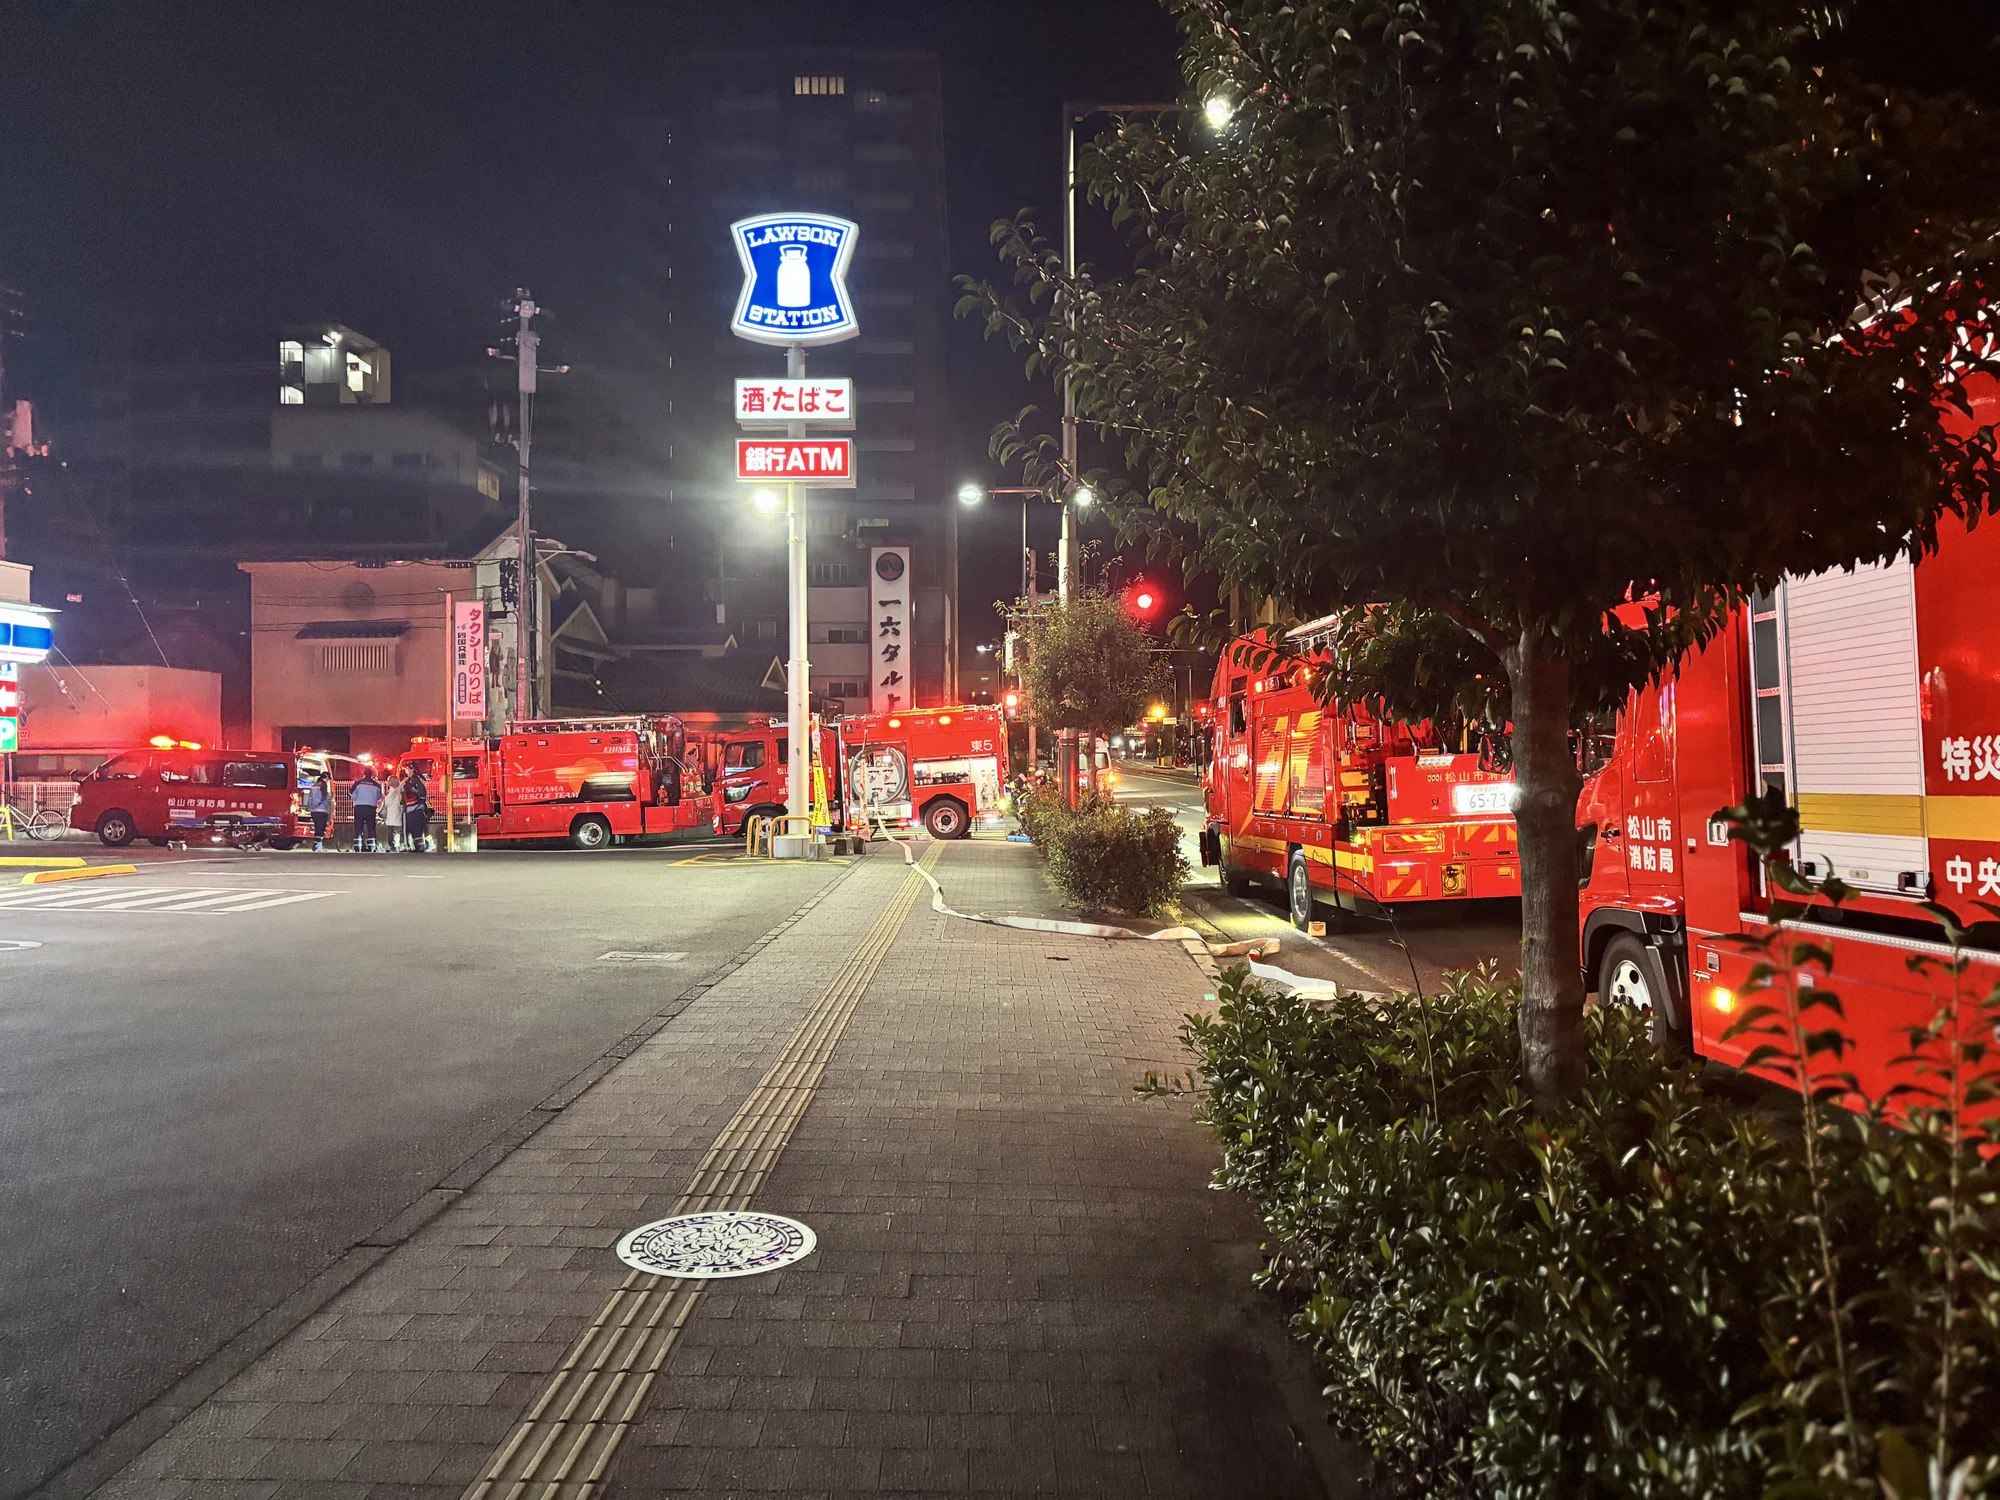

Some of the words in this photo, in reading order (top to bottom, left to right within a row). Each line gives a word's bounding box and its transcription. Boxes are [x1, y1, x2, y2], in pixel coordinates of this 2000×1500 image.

[747, 226, 841, 248] LAWSON
[748, 305, 840, 327] STATION
[745, 446, 843, 473] 銀行ATM
[469, 608, 481, 704] タクシーのりば
[879, 598, 903, 713] 一六タルト
[603, 745, 632, 754] EHIME
[970, 739, 993, 752] 東5
[1941, 735, 2000, 782] 特災
[506, 785, 565, 794] MATSUYAMA
[517, 792, 552, 800] RESCUE
[555, 791, 579, 799] TEAM
[167, 798, 225, 808] 松山市消防局
[1627, 815, 1671, 842] 松山市
[1629, 845, 1673, 873] 消防局
[1946, 854, 2000, 897] 中央
